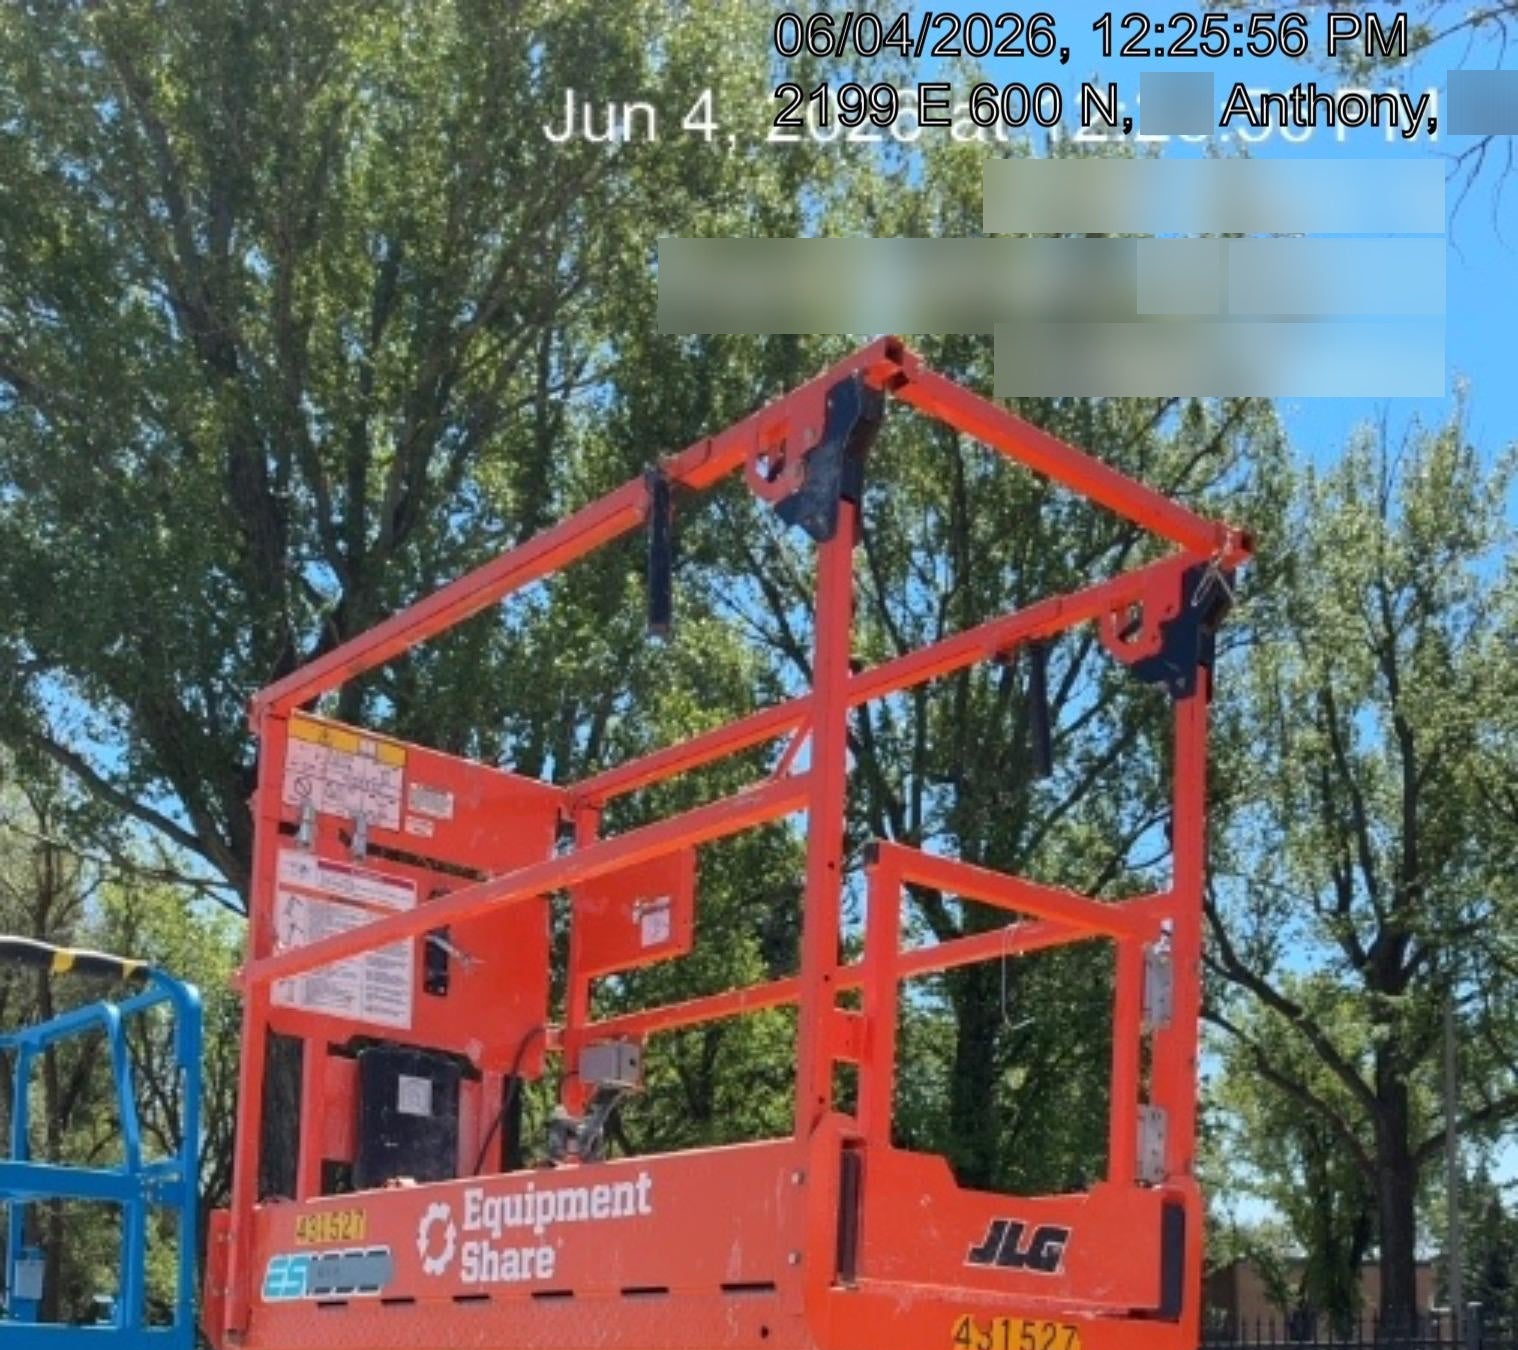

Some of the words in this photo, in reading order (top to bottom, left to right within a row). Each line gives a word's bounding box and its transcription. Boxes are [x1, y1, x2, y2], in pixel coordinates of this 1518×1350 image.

[461, 1171, 653, 1239] Equipment
[461, 1240, 556, 1284] Share
[964, 1218, 1072, 1275] JLG
